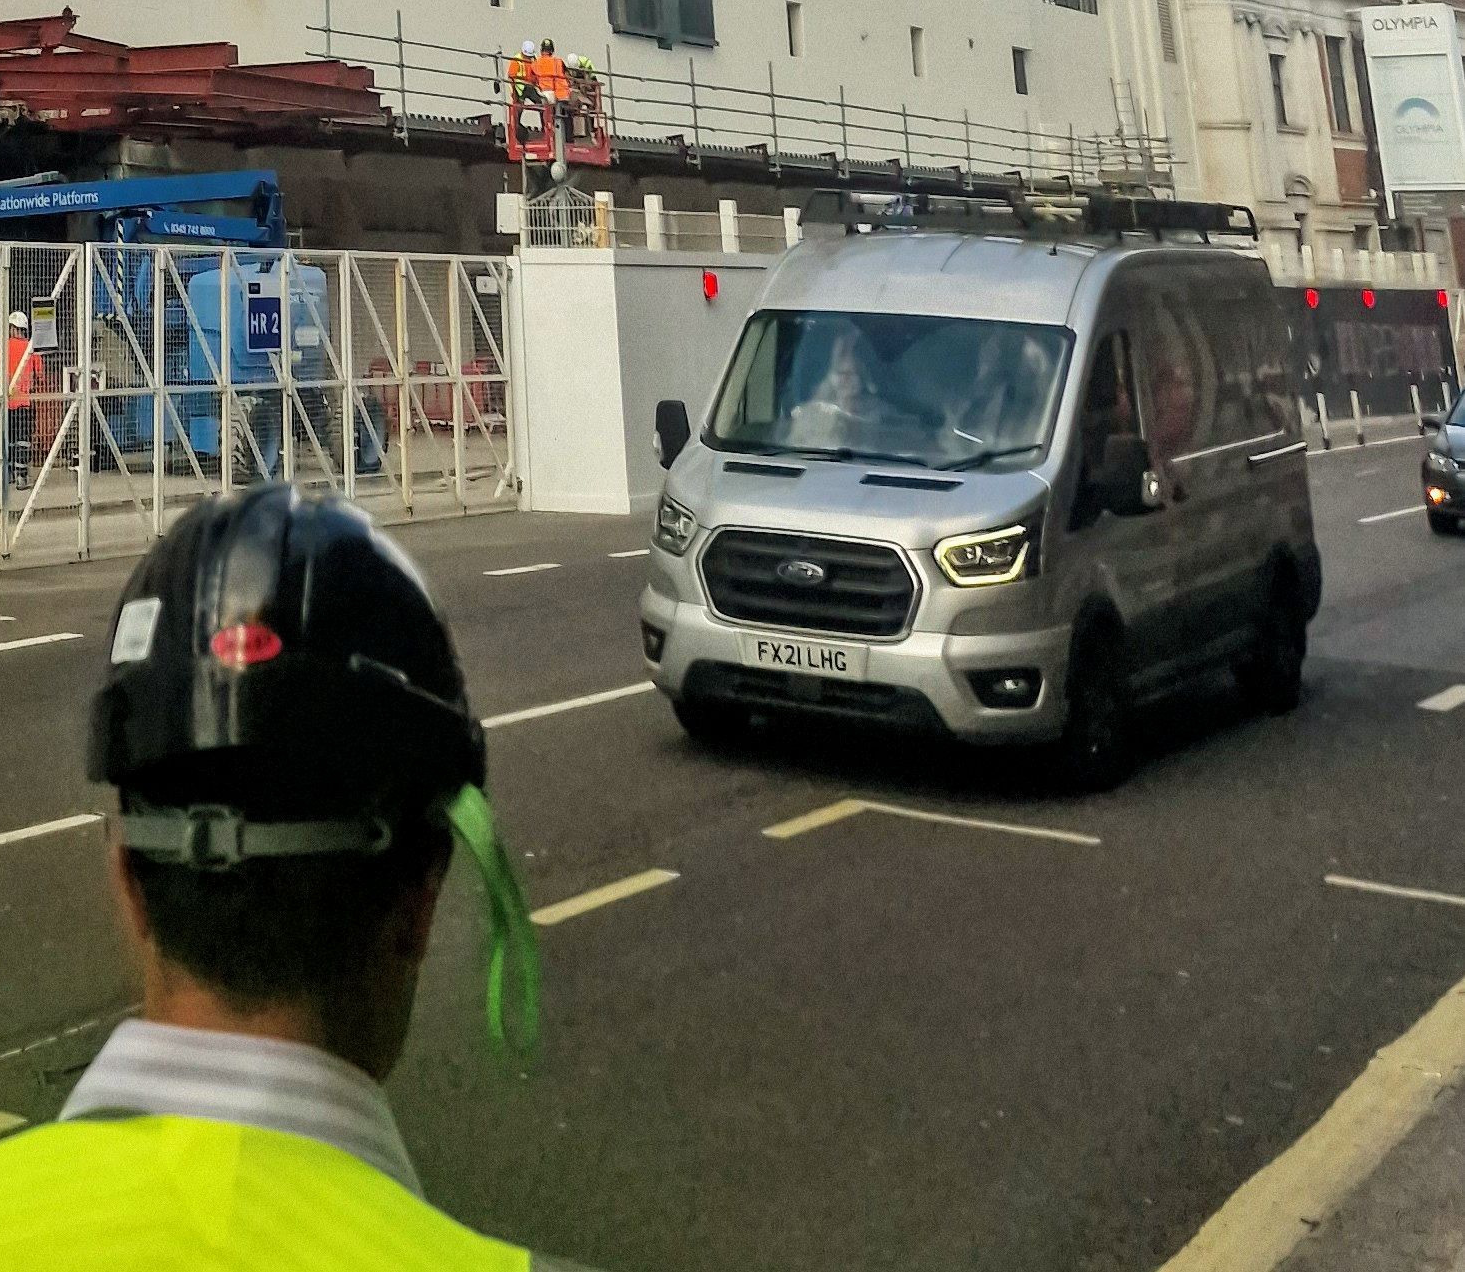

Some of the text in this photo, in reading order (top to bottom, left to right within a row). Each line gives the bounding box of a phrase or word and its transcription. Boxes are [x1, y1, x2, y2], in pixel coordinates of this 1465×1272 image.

[1372, 16, 1439, 31] OLYMPIA
[52, 191, 99, 207] Platforms
[250, 311, 280, 335] HR 2
[757, 640, 847, 672] FX21 LHG
